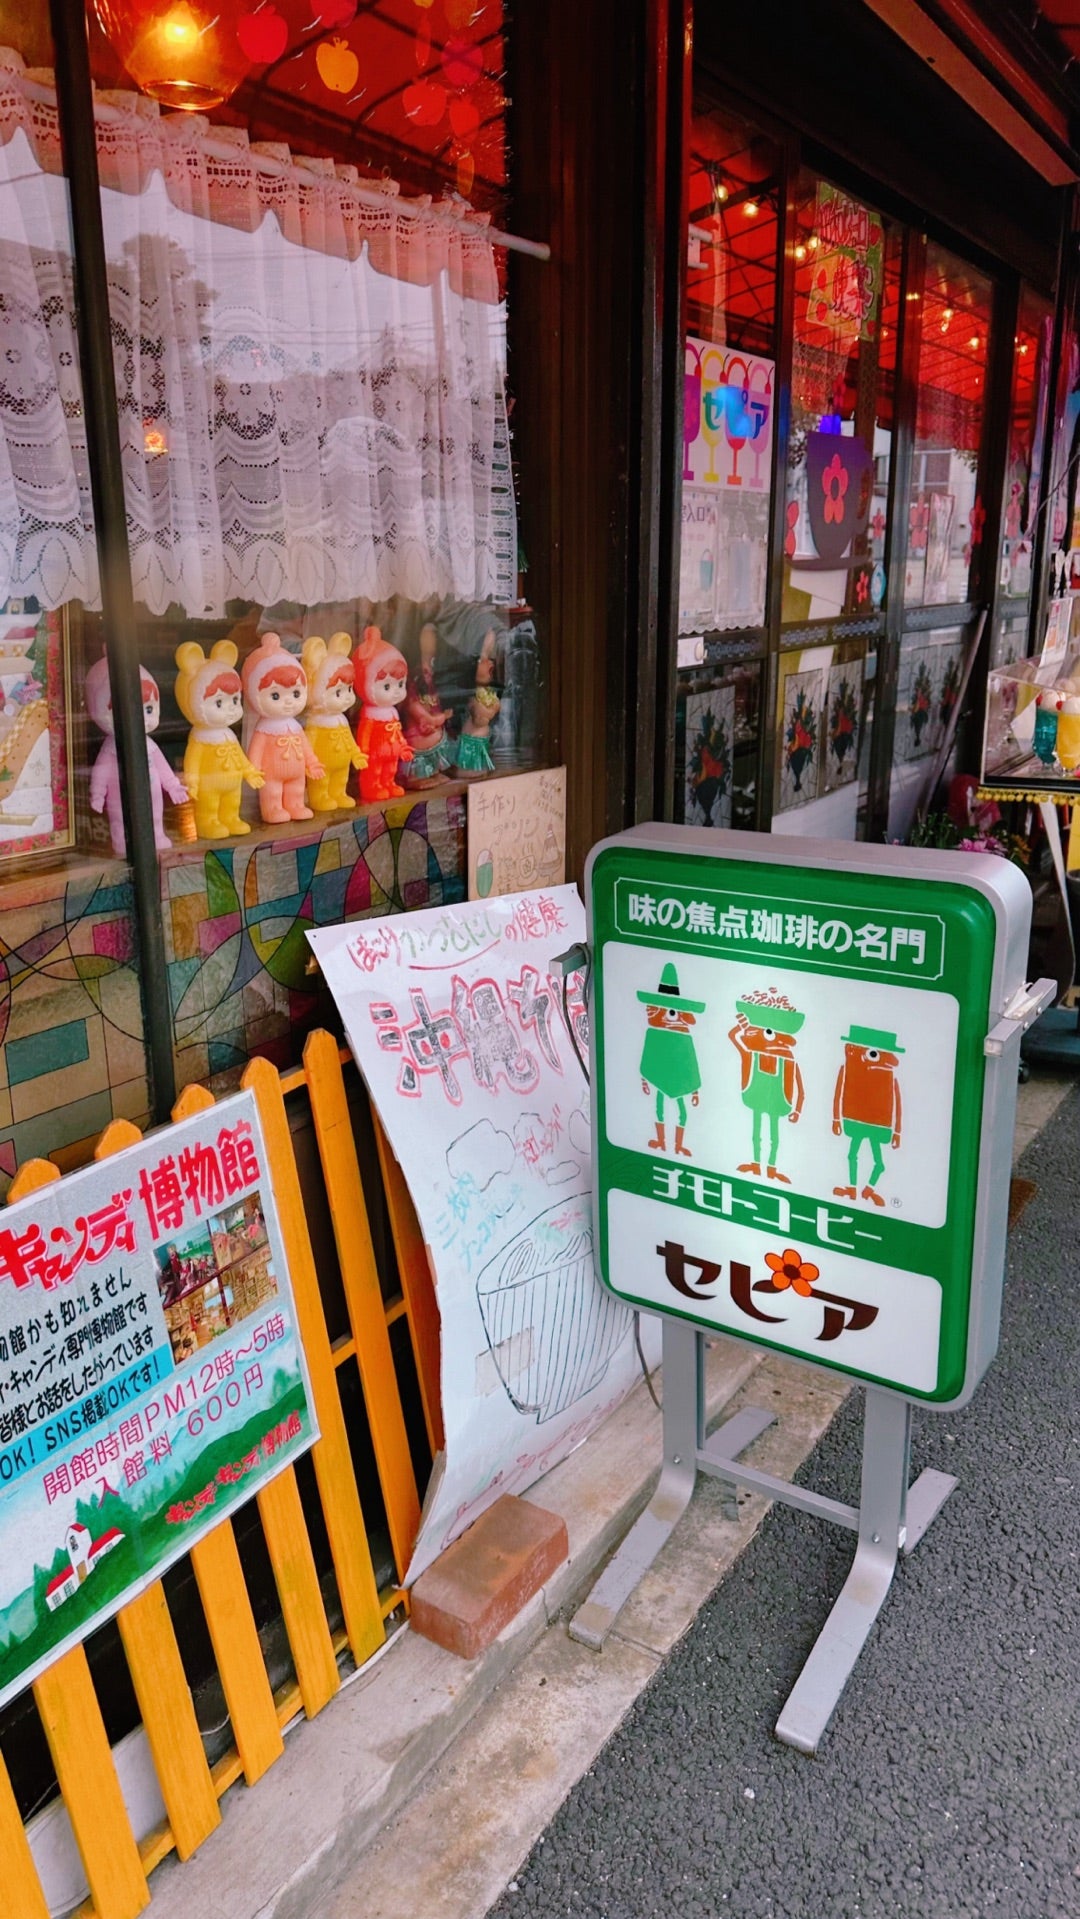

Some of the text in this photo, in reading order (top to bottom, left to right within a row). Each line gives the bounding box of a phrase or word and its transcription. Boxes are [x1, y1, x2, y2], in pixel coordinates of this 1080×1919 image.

[628, 893, 926, 965] 味の焦点珈琲の名門
[653, 1165, 883, 1250] チモトコーヒー
[656, 1240, 879, 1341] セピア
[187, 1363, 264, 1437] 600円
